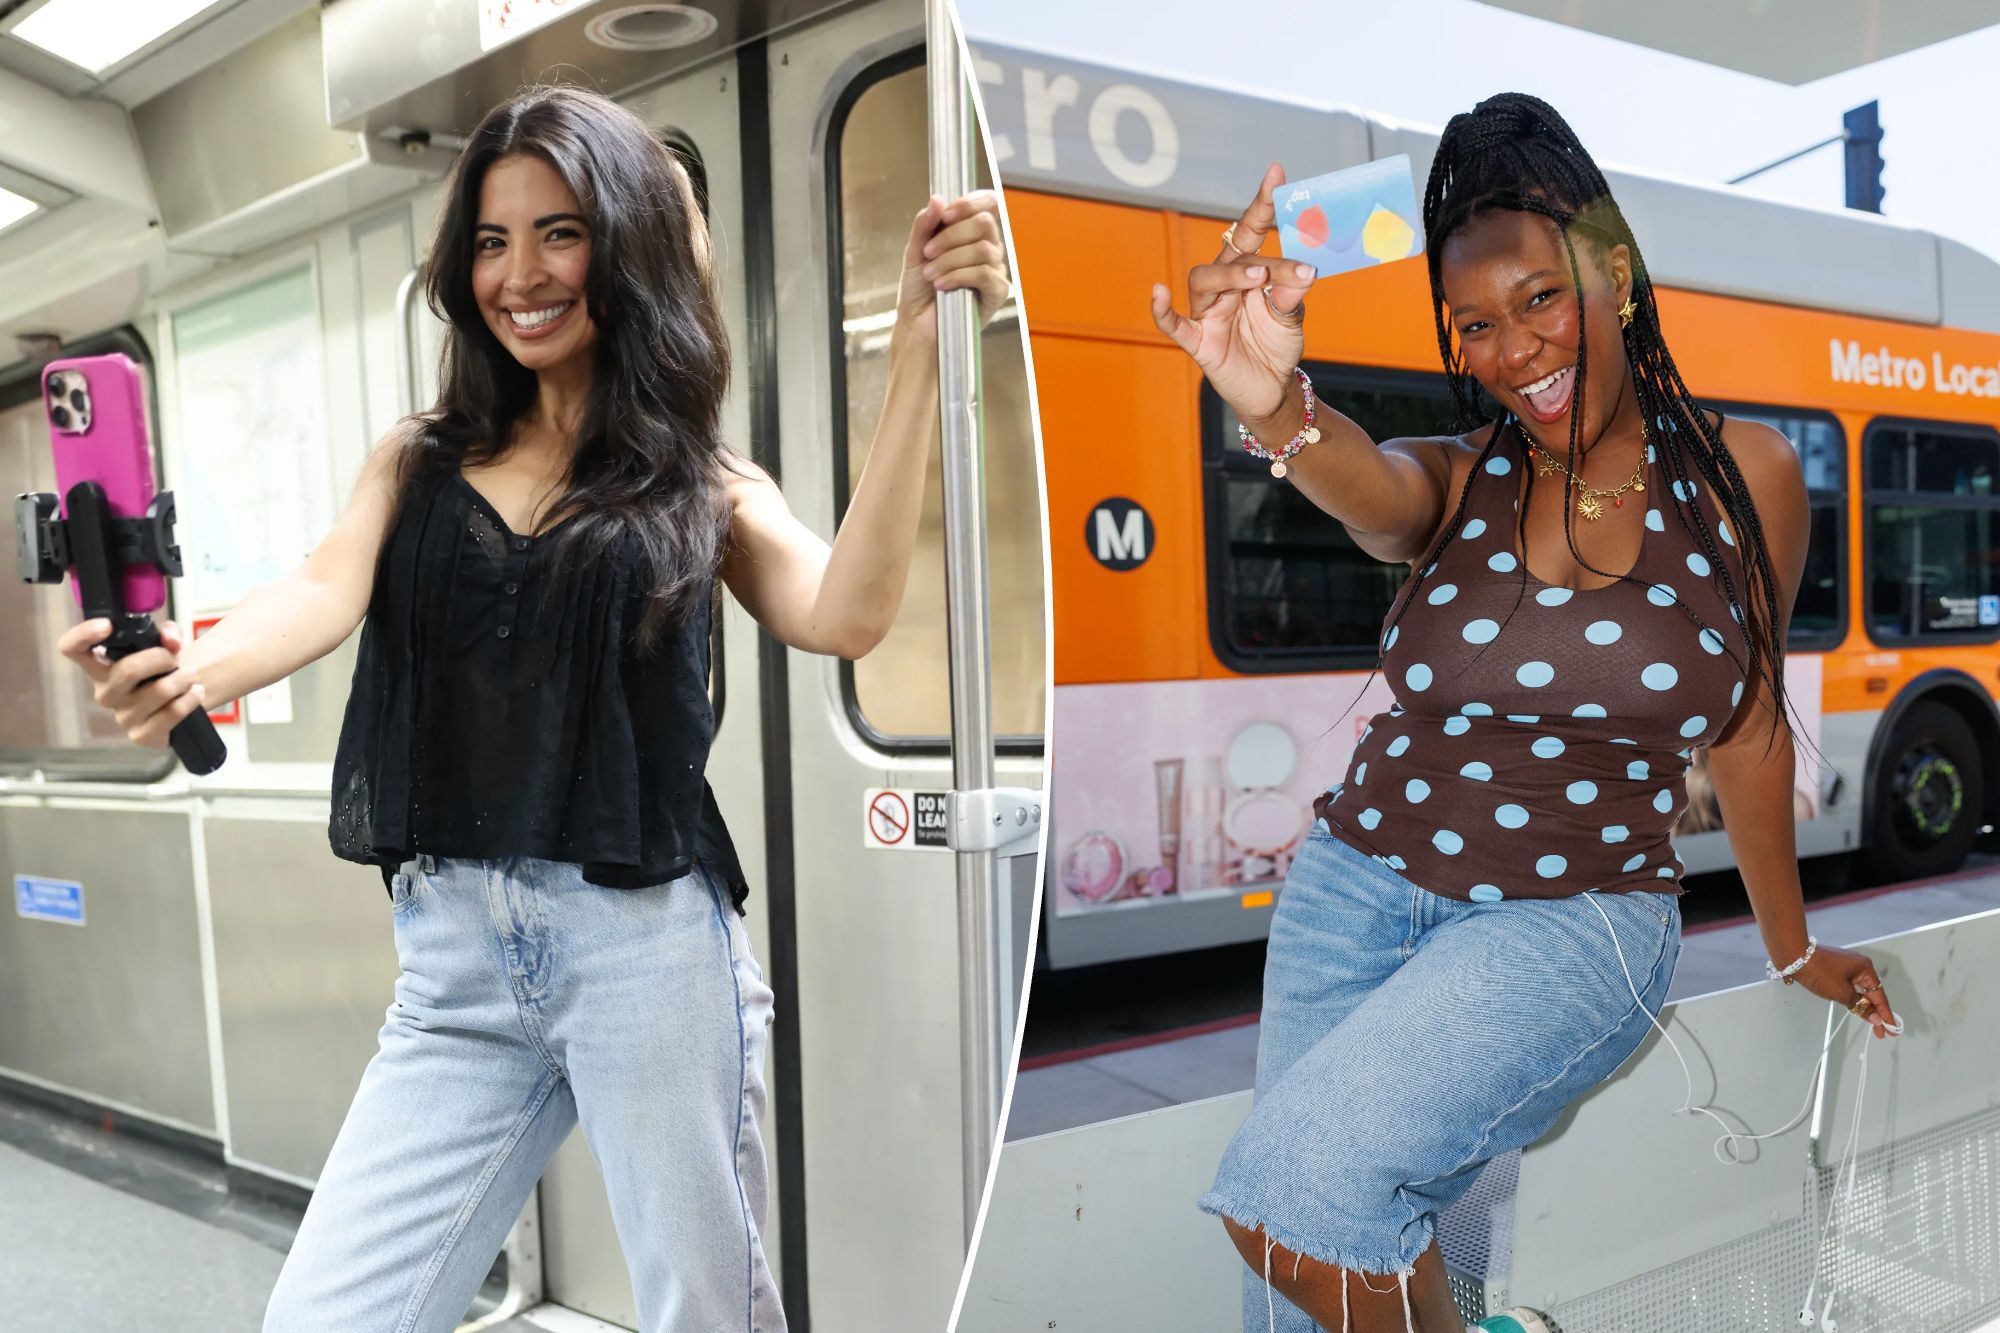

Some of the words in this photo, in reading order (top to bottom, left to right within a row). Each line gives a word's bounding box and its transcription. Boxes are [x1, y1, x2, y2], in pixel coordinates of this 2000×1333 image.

[1830, 338, 1926, 390] Metro
[1932, 351, 2000, 398] Loca
[1095, 508, 1146, 561] M
[917, 796, 936, 811] DO
[937, 797, 946, 812] N
